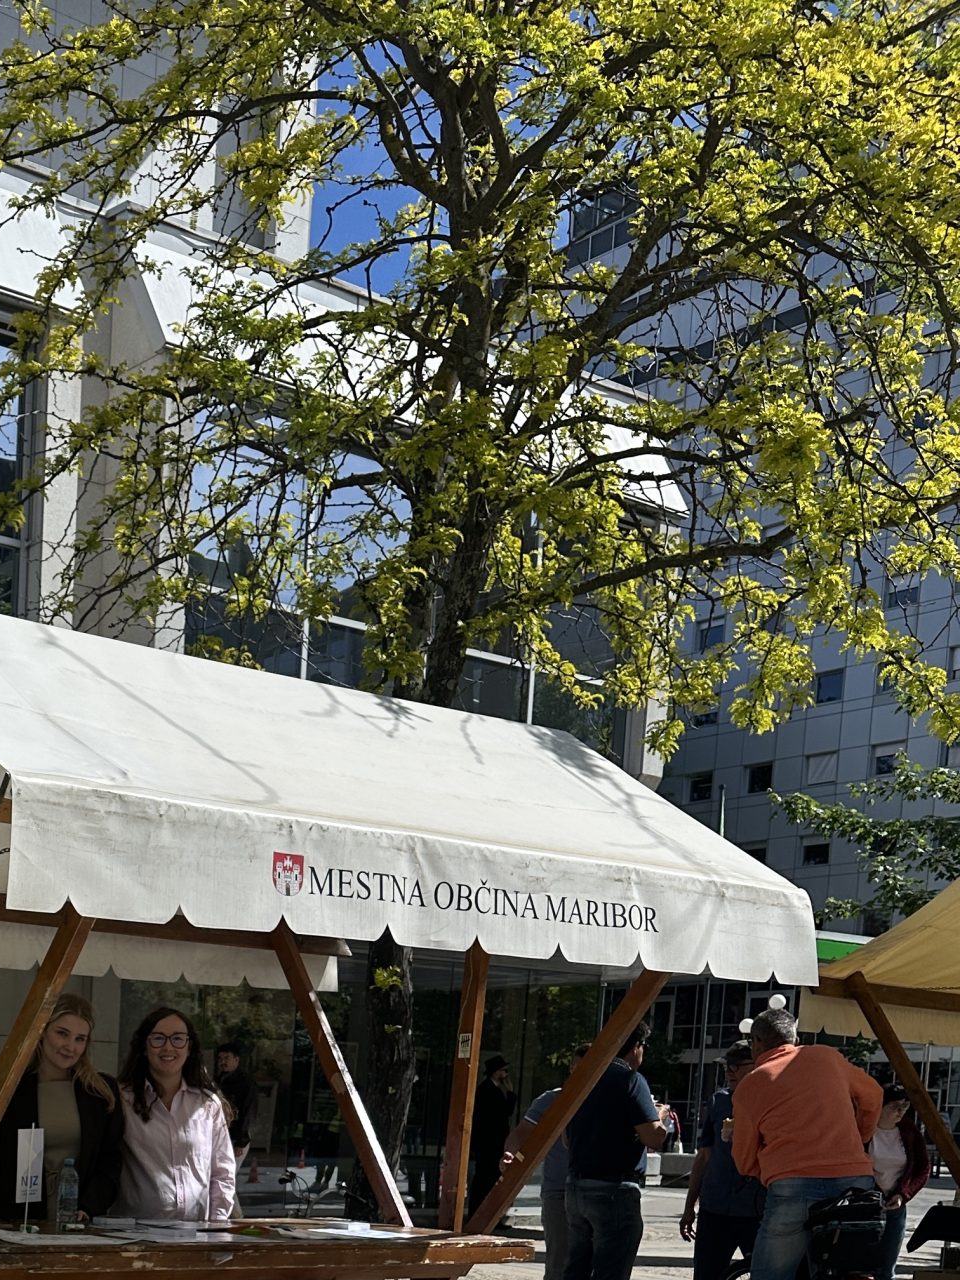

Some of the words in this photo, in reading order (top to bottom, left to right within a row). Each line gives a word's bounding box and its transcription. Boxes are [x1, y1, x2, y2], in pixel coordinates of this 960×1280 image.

[308, 865, 427, 908] MESTNA
[433, 878, 540, 920] OBČINA
[544, 894, 660, 933] MARIBOR
[20, 1175, 39, 1189] NJZ
